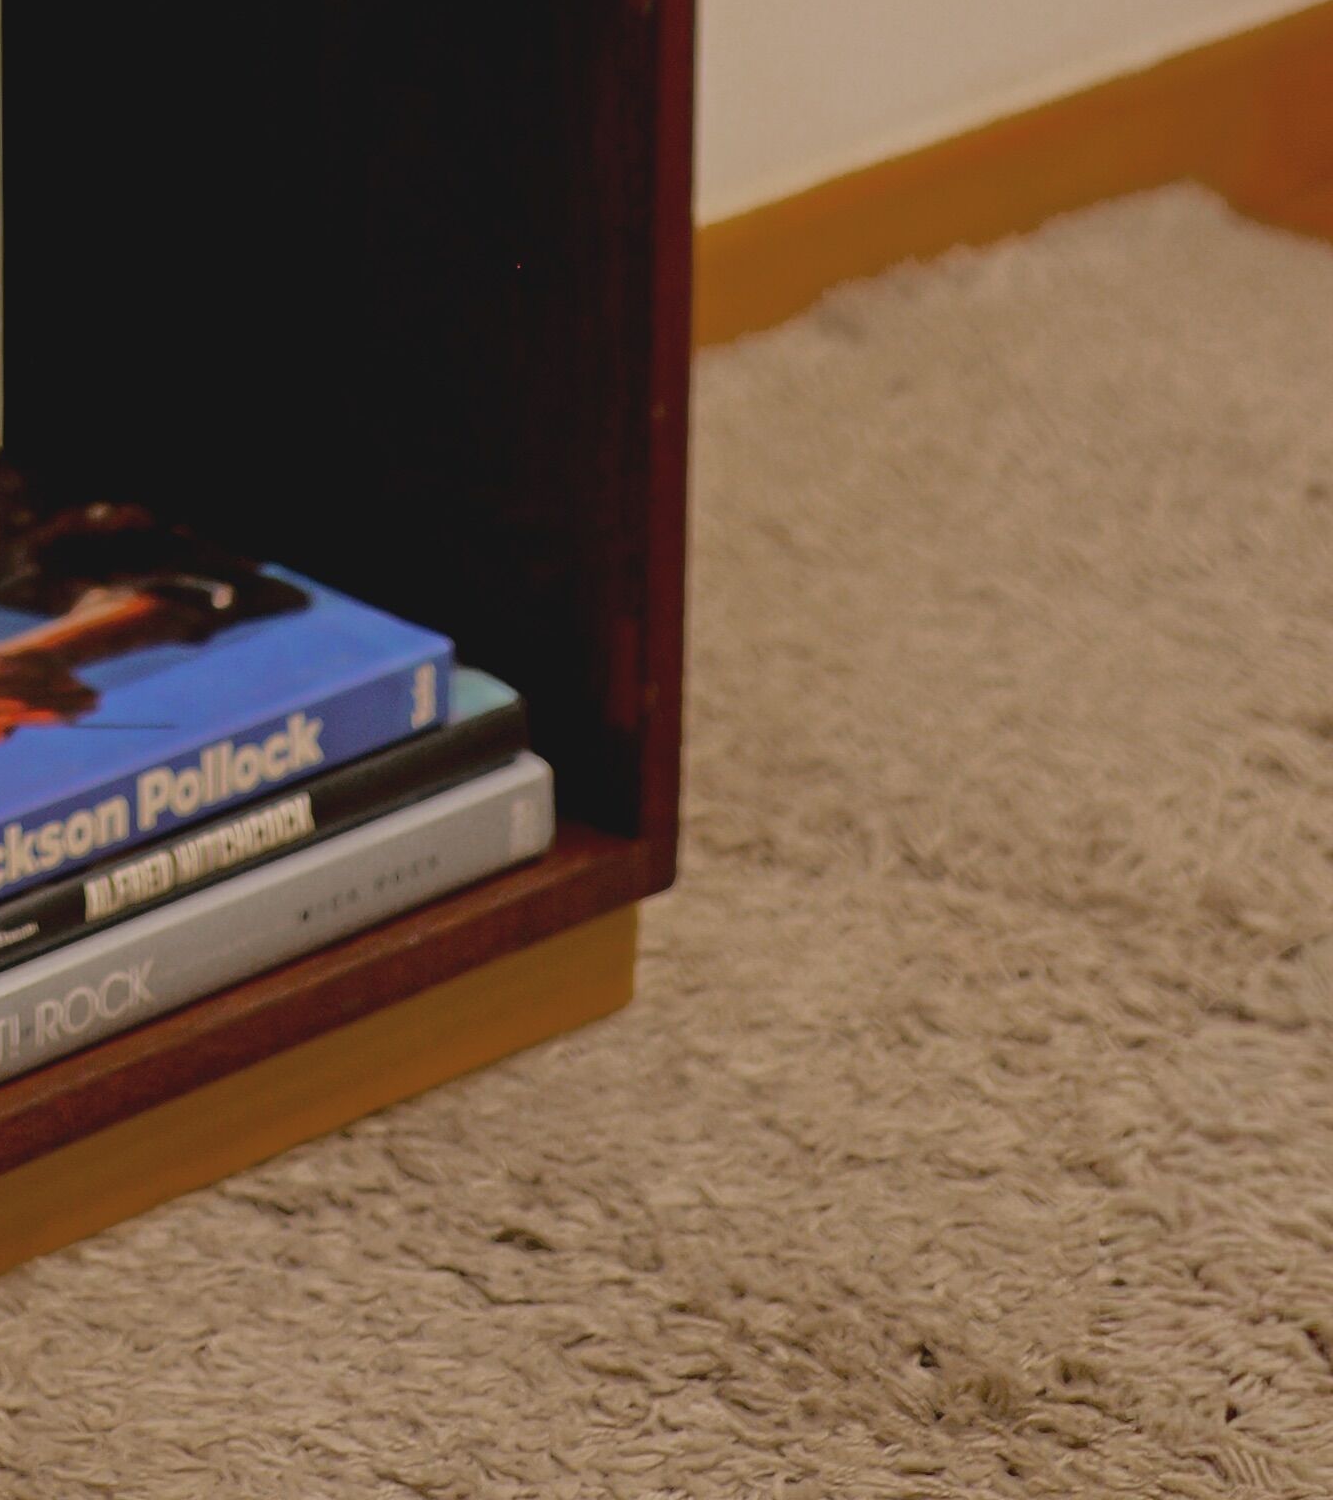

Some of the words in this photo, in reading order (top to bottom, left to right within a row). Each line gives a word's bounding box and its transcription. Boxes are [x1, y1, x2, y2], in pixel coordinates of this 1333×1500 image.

[136, 711, 324, 831] Pollock
[84, 850, 176, 923] ALFRED
[174, 791, 316, 888] HITCHCOCK
[34, 959, 154, 1048] ROCK
